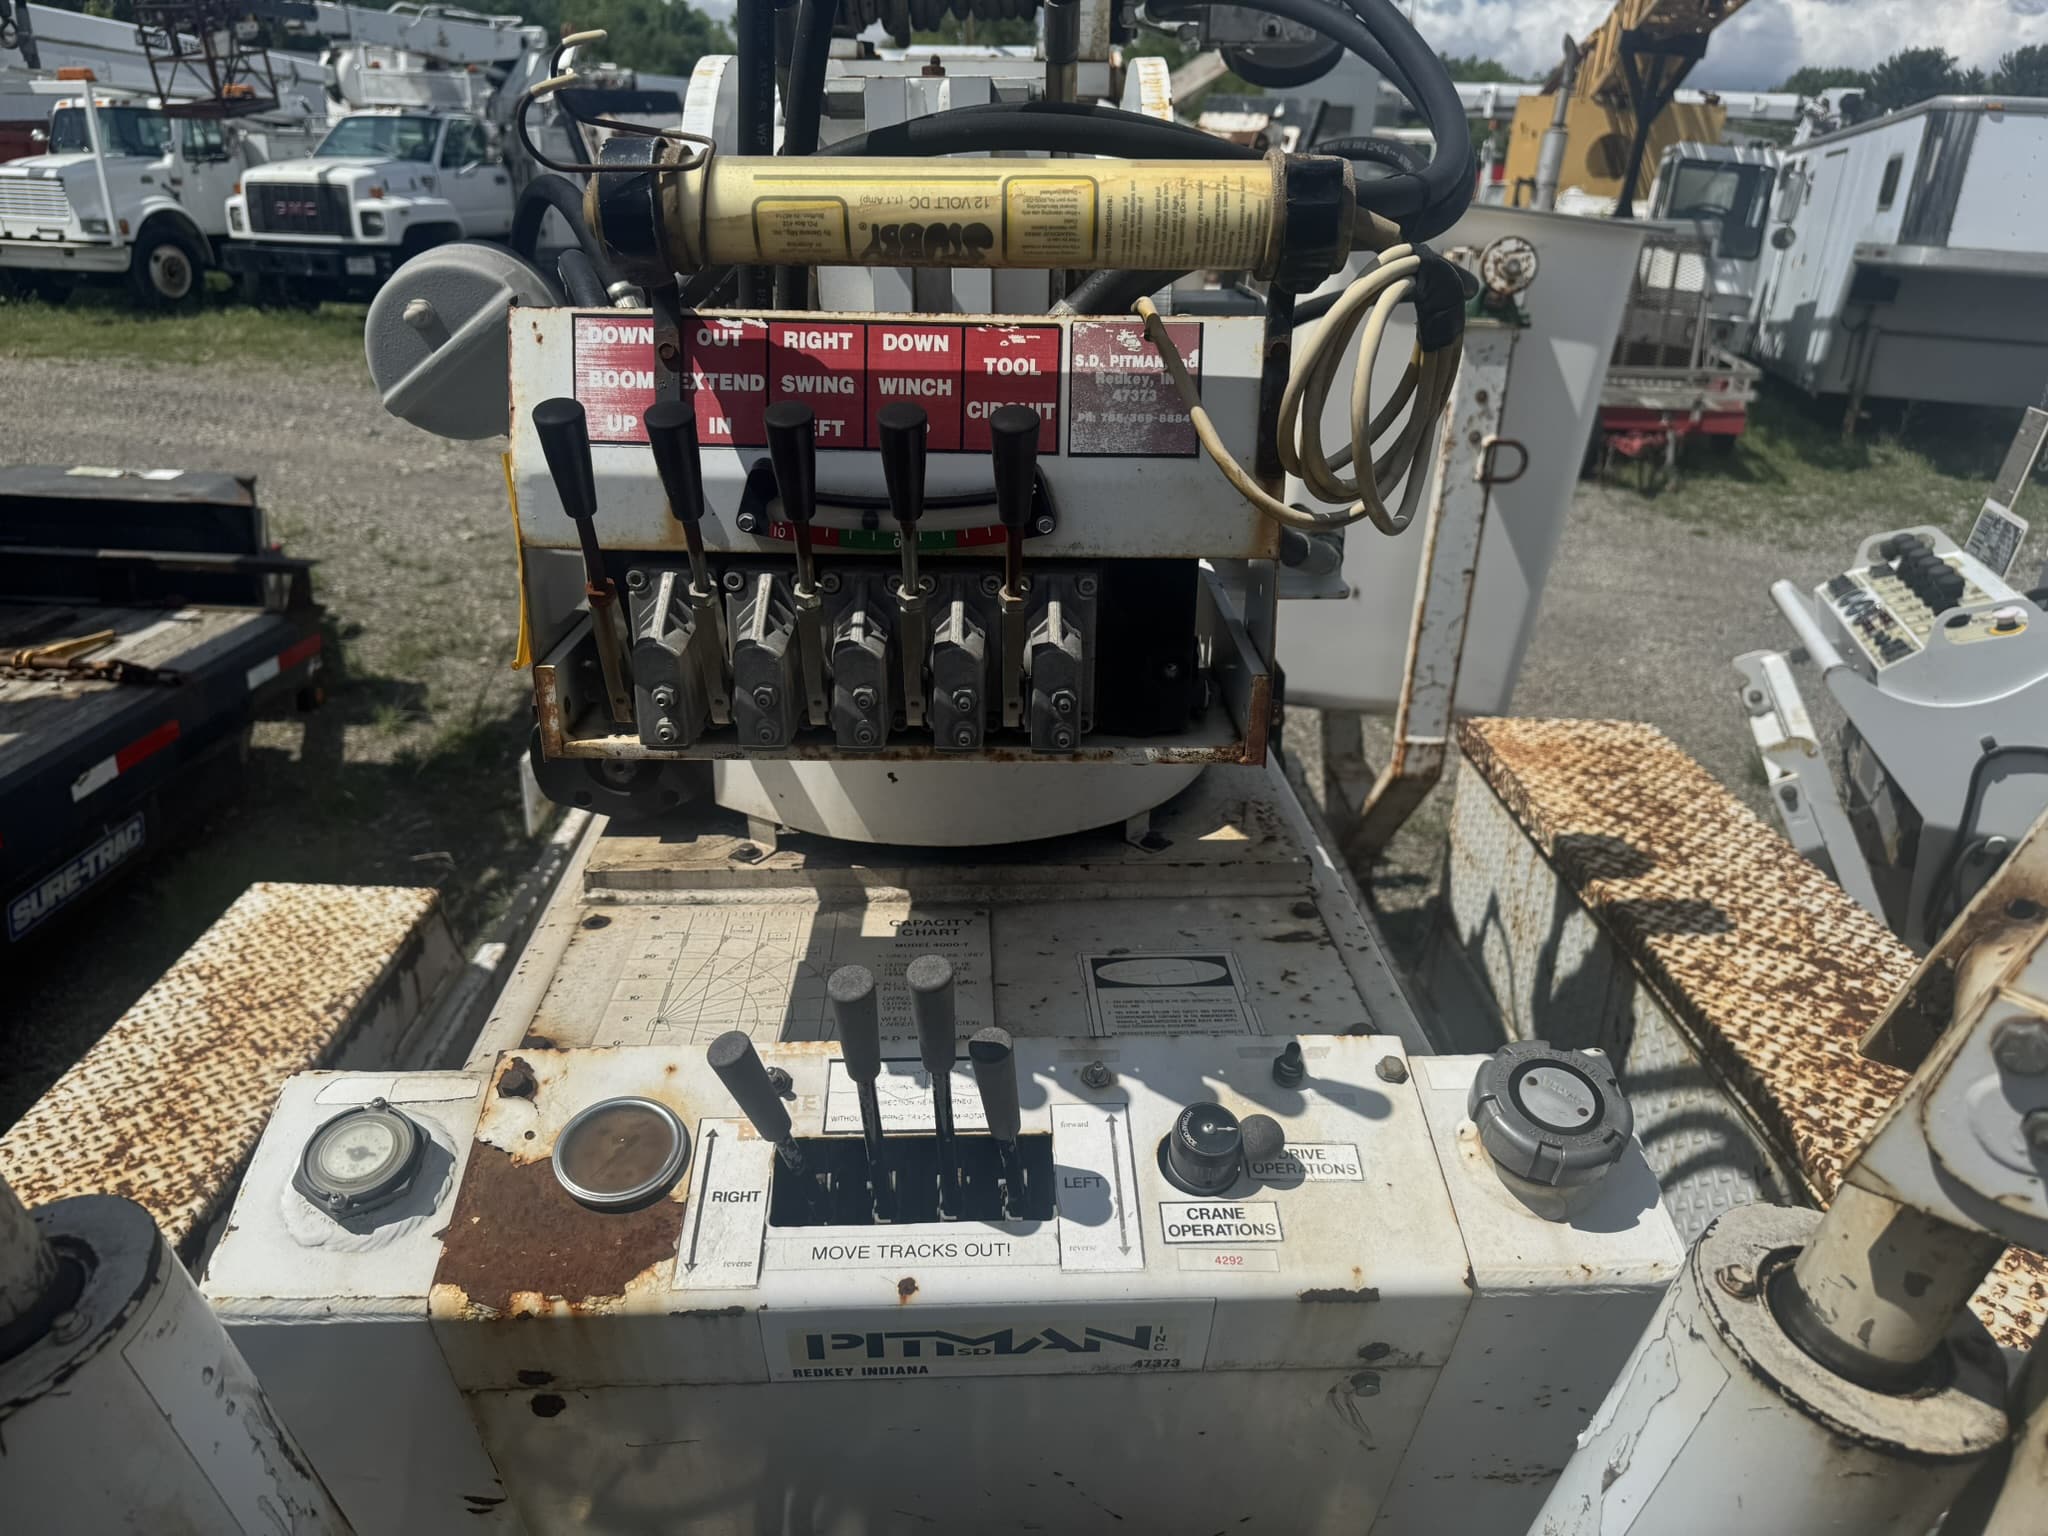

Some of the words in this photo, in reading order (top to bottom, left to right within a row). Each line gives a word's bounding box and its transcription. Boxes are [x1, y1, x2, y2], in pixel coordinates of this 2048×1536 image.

[860, 195, 884, 206] Amp)
[909, 196, 930, 209] DC
[933, 196, 971, 209] VOLT
[974, 196, 990, 209] 12
[274, 200, 318, 217] GMC
[587, 326, 654, 345] DOWN
[696, 328, 744, 347] OUT
[783, 331, 854, 350] RIGHT
[882, 333, 949, 352] DOWN
[984, 358, 1042, 376] TOOL
[588, 371, 655, 389] BOOM
[680, 372, 766, 391] EXTEND
[781, 374, 855, 394] SWING
[1096, 371, 1155, 387] Redkey,
[878, 377, 952, 396] WINCH
[966, 401, 1056, 420] CIIT
[606, 414, 638, 432] UP
[709, 416, 732, 435] IN
[814, 419, 845, 437] FT
[13, 820, 141, 932] SURE-TRAC
[889, 918, 973, 928] CAPACITY
[902, 927, 961, 937] CHART
[830, 1114, 860, 1123] WITHOU
[1060, 1120, 1089, 1129] forward
[1280, 1148, 1327, 1160] DRIVE
[1252, 1162, 1358, 1175] OPERATIONS
[1064, 1176, 1102, 1189] LEFT
[711, 1190, 762, 1203] RIGHT
[1186, 1207, 1245, 1220] CRANE
[1168, 1223, 1277, 1237] OPERATIONS
[811, 1245, 871, 1260] MOVE
[877, 1243, 958, 1259] TRACKS
[964, 1242, 1011, 1258] OUT!
[1069, 1244, 1097, 1253] reverse
[722, 1259, 753, 1268] reverse
[1214, 1255, 1244, 1265] 4292
[806, 1325, 1153, 1360] PITMAN
[957, 1347, 991, 1356] SD
[1131, 1358, 1181, 1369] 47373
[792, 1366, 854, 1379] REDKEY
[861, 1364, 929, 1377] INDIANA
